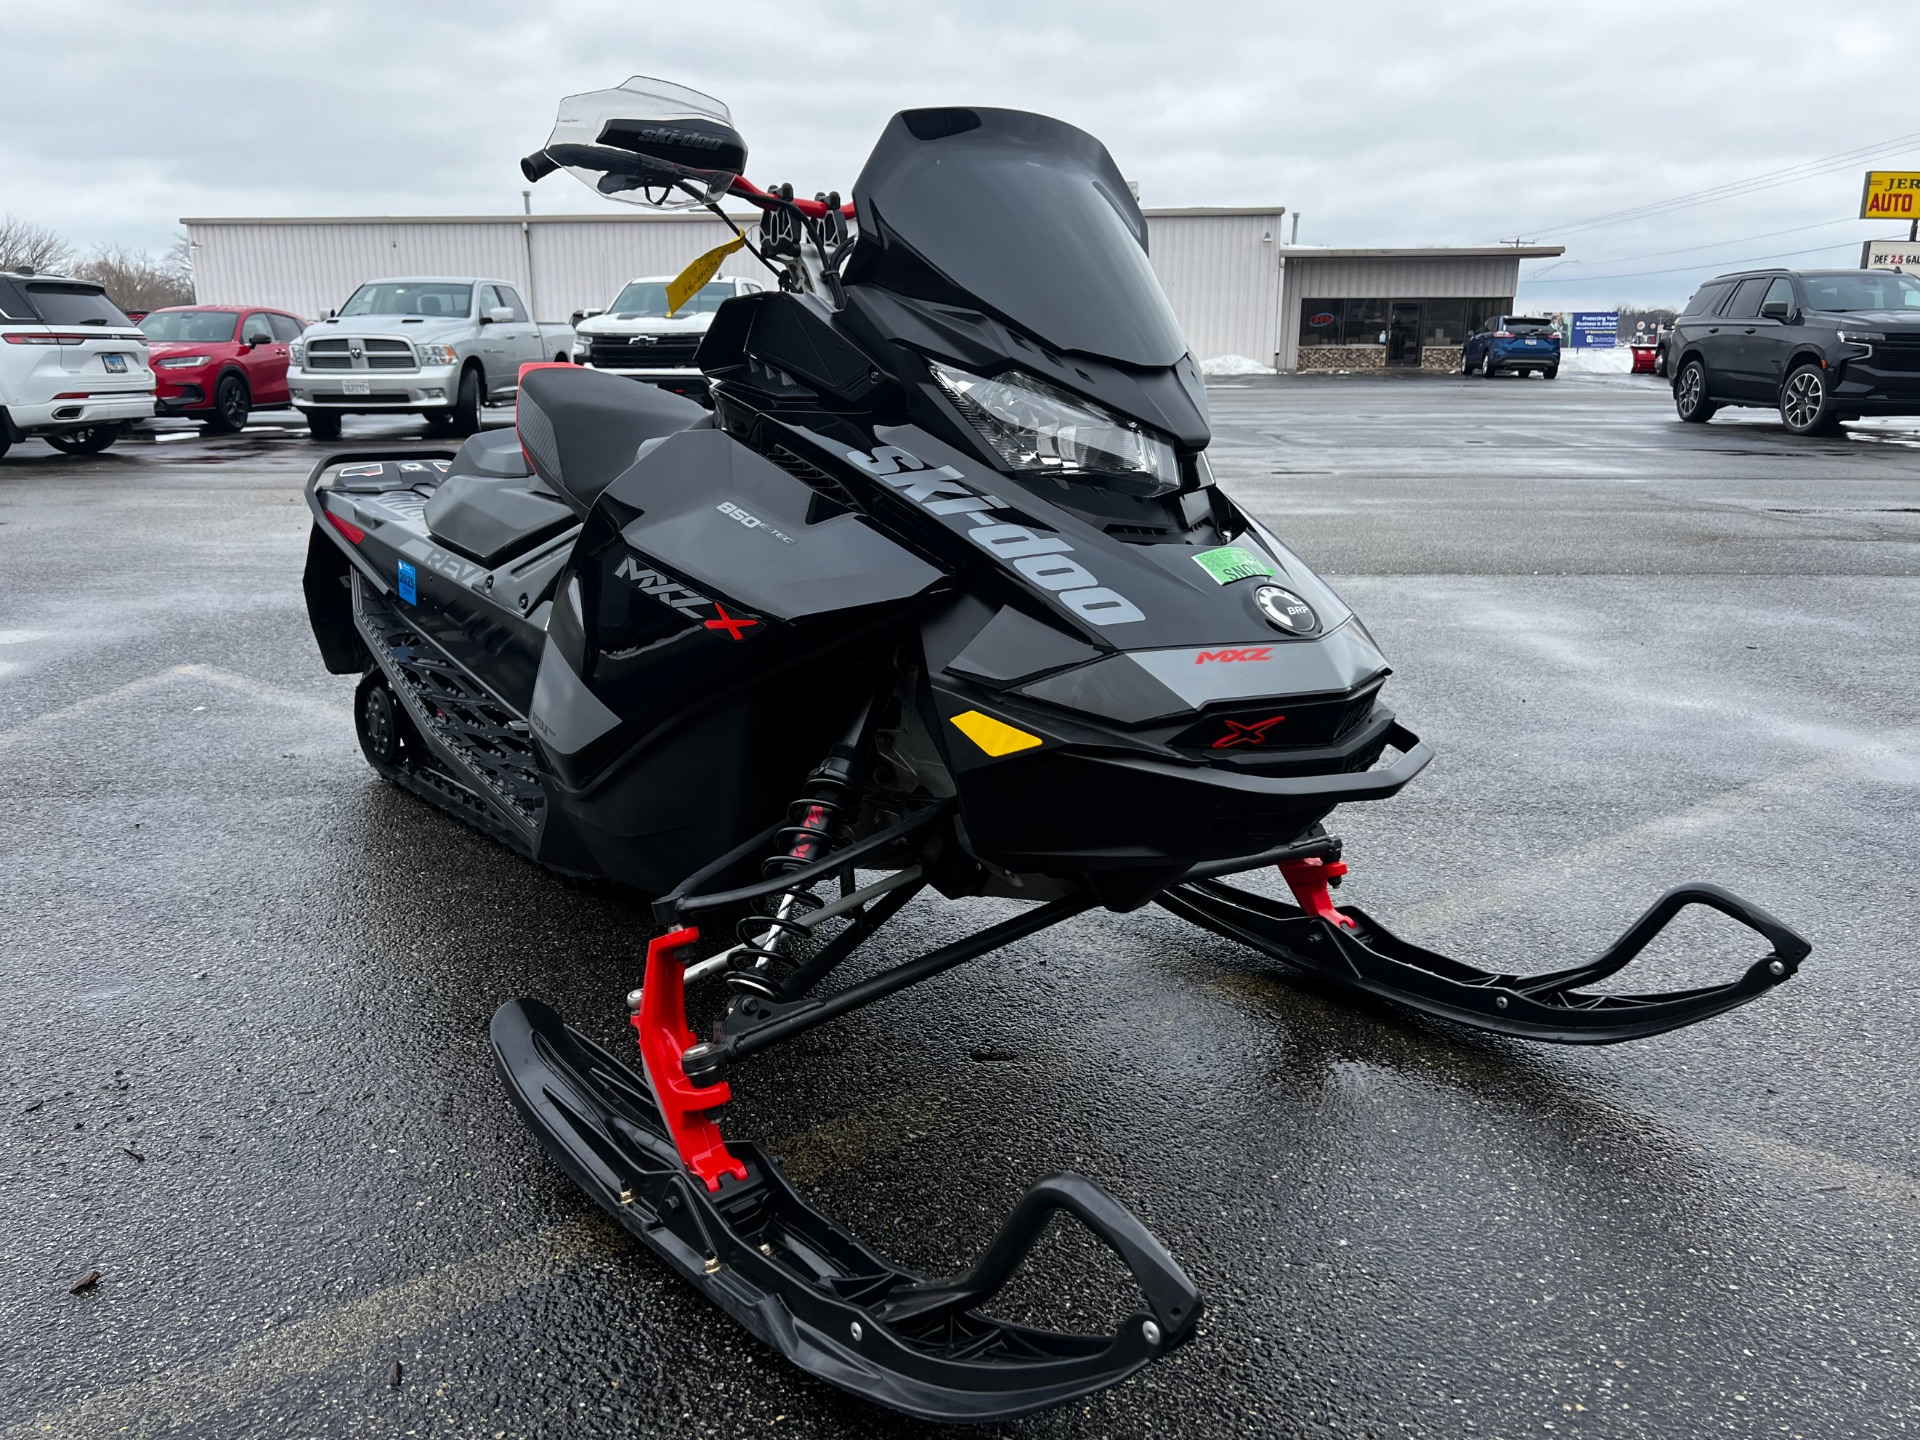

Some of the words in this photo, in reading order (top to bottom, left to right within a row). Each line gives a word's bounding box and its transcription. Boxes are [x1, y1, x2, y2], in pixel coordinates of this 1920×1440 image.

[638, 127, 723, 150] ski-doo
[1868, 193, 1913, 212] AUTO
[1874, 254, 1888, 264] DEF
[1890, 254, 1904, 264] 2.5
[716, 501, 762, 530] 850
[758, 523, 795, 544] E-TEC
[847, 445, 1146, 625] ski-doo
[399, 572, 414, 589] 2025
[614, 557, 713, 619] MXZ
[704, 602, 758, 640] X
[1287, 606, 1308, 615] BRP
[1195, 648, 1274, 664] MXZ
